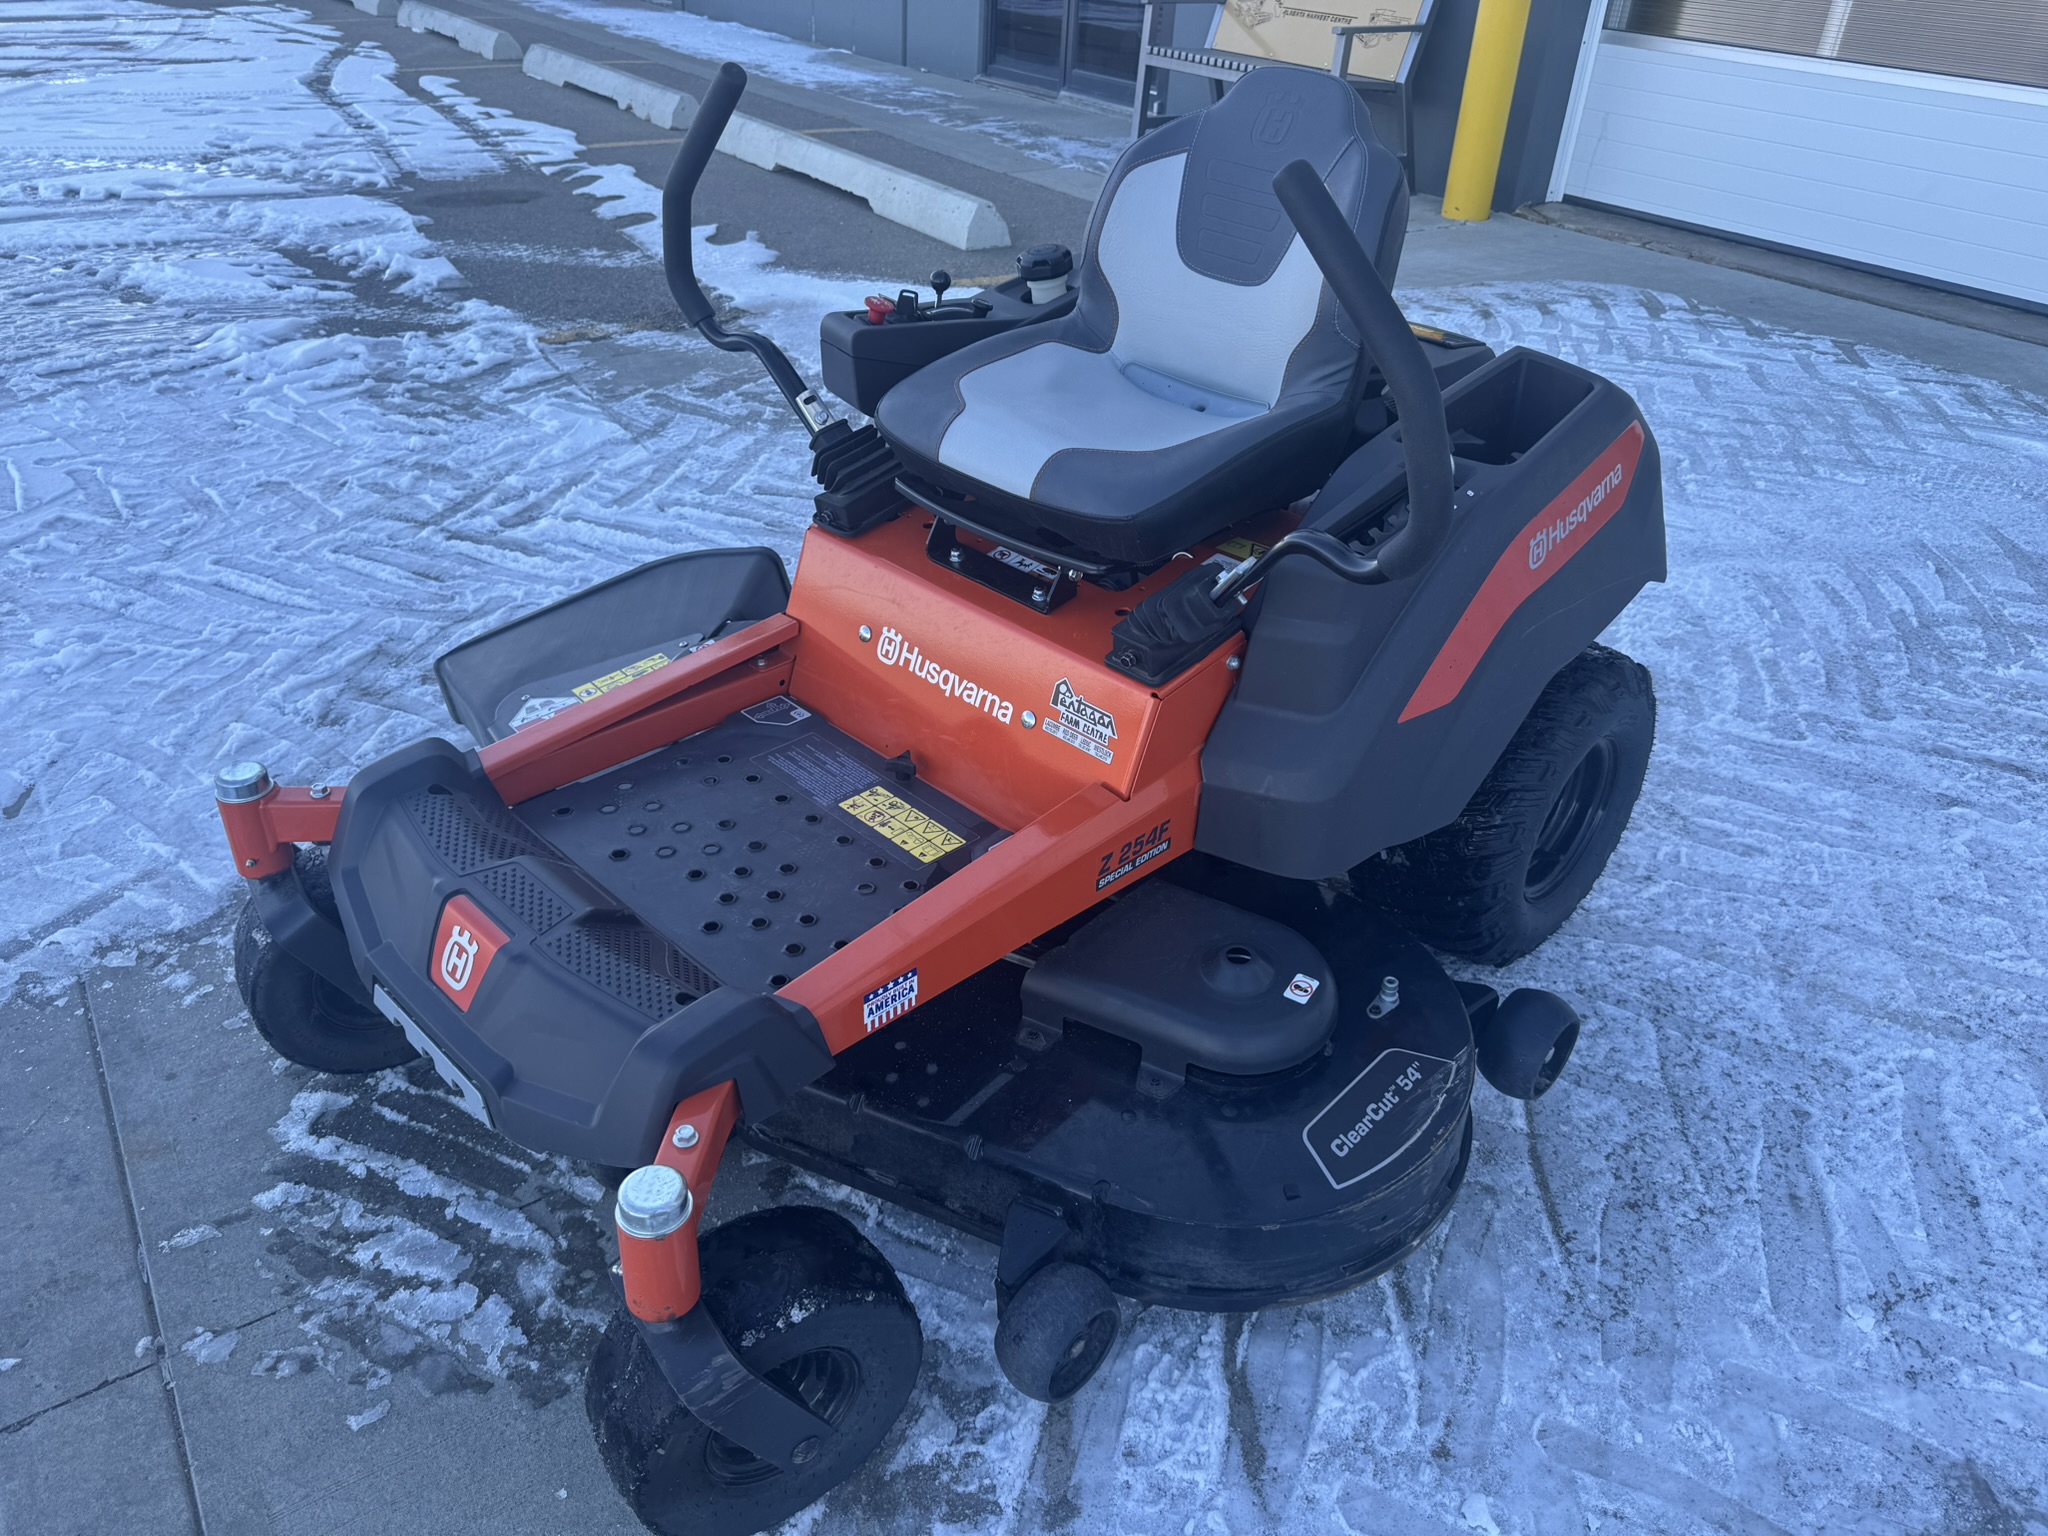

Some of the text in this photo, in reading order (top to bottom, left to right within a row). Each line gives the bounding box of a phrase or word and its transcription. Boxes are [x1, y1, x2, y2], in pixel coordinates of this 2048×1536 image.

[1282, 10, 1353, 25] ALBERTA HARVEST CENTRE
[1548, 463, 1622, 551] Husqvarna
[899, 643, 1014, 724] Husqvarna
[1051, 679, 1117, 737] Pentagon
[1060, 712, 1080, 730] FARM
[1082, 723, 1108, 744] CENTRE
[1097, 819, 1171, 877] Z 254F
[1098, 840, 1170, 889] SPECIAL EDITION
[867, 984, 915, 1018] AMERICA
[1396, 1060, 1423, 1092] 54"
